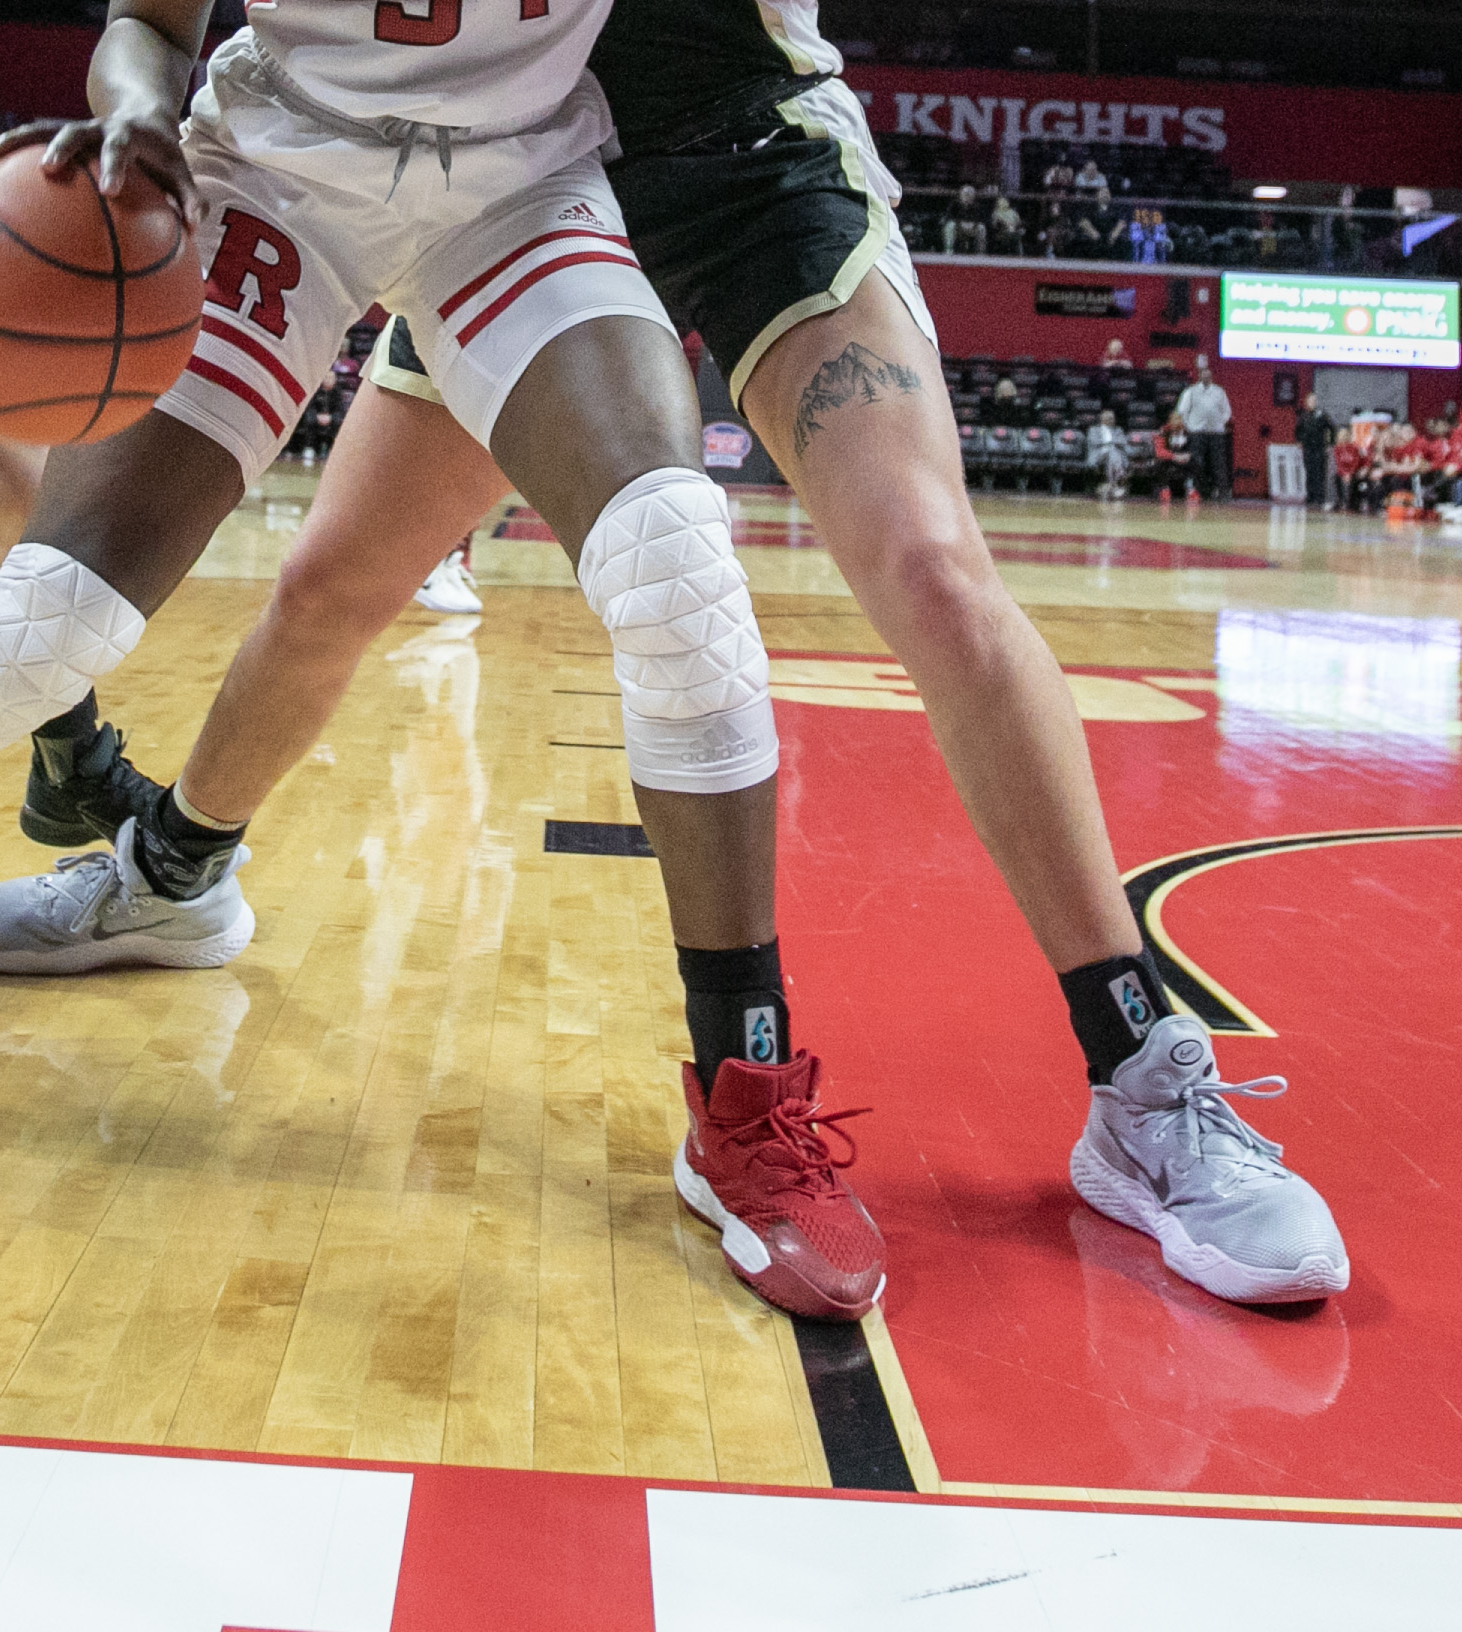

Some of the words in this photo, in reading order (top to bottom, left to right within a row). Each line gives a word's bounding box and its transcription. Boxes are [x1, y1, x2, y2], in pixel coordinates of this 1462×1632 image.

[895, 92, 1228, 152] KNIGHTS
[558, 213, 605, 227] adidas
[205, 207, 303, 340] R
